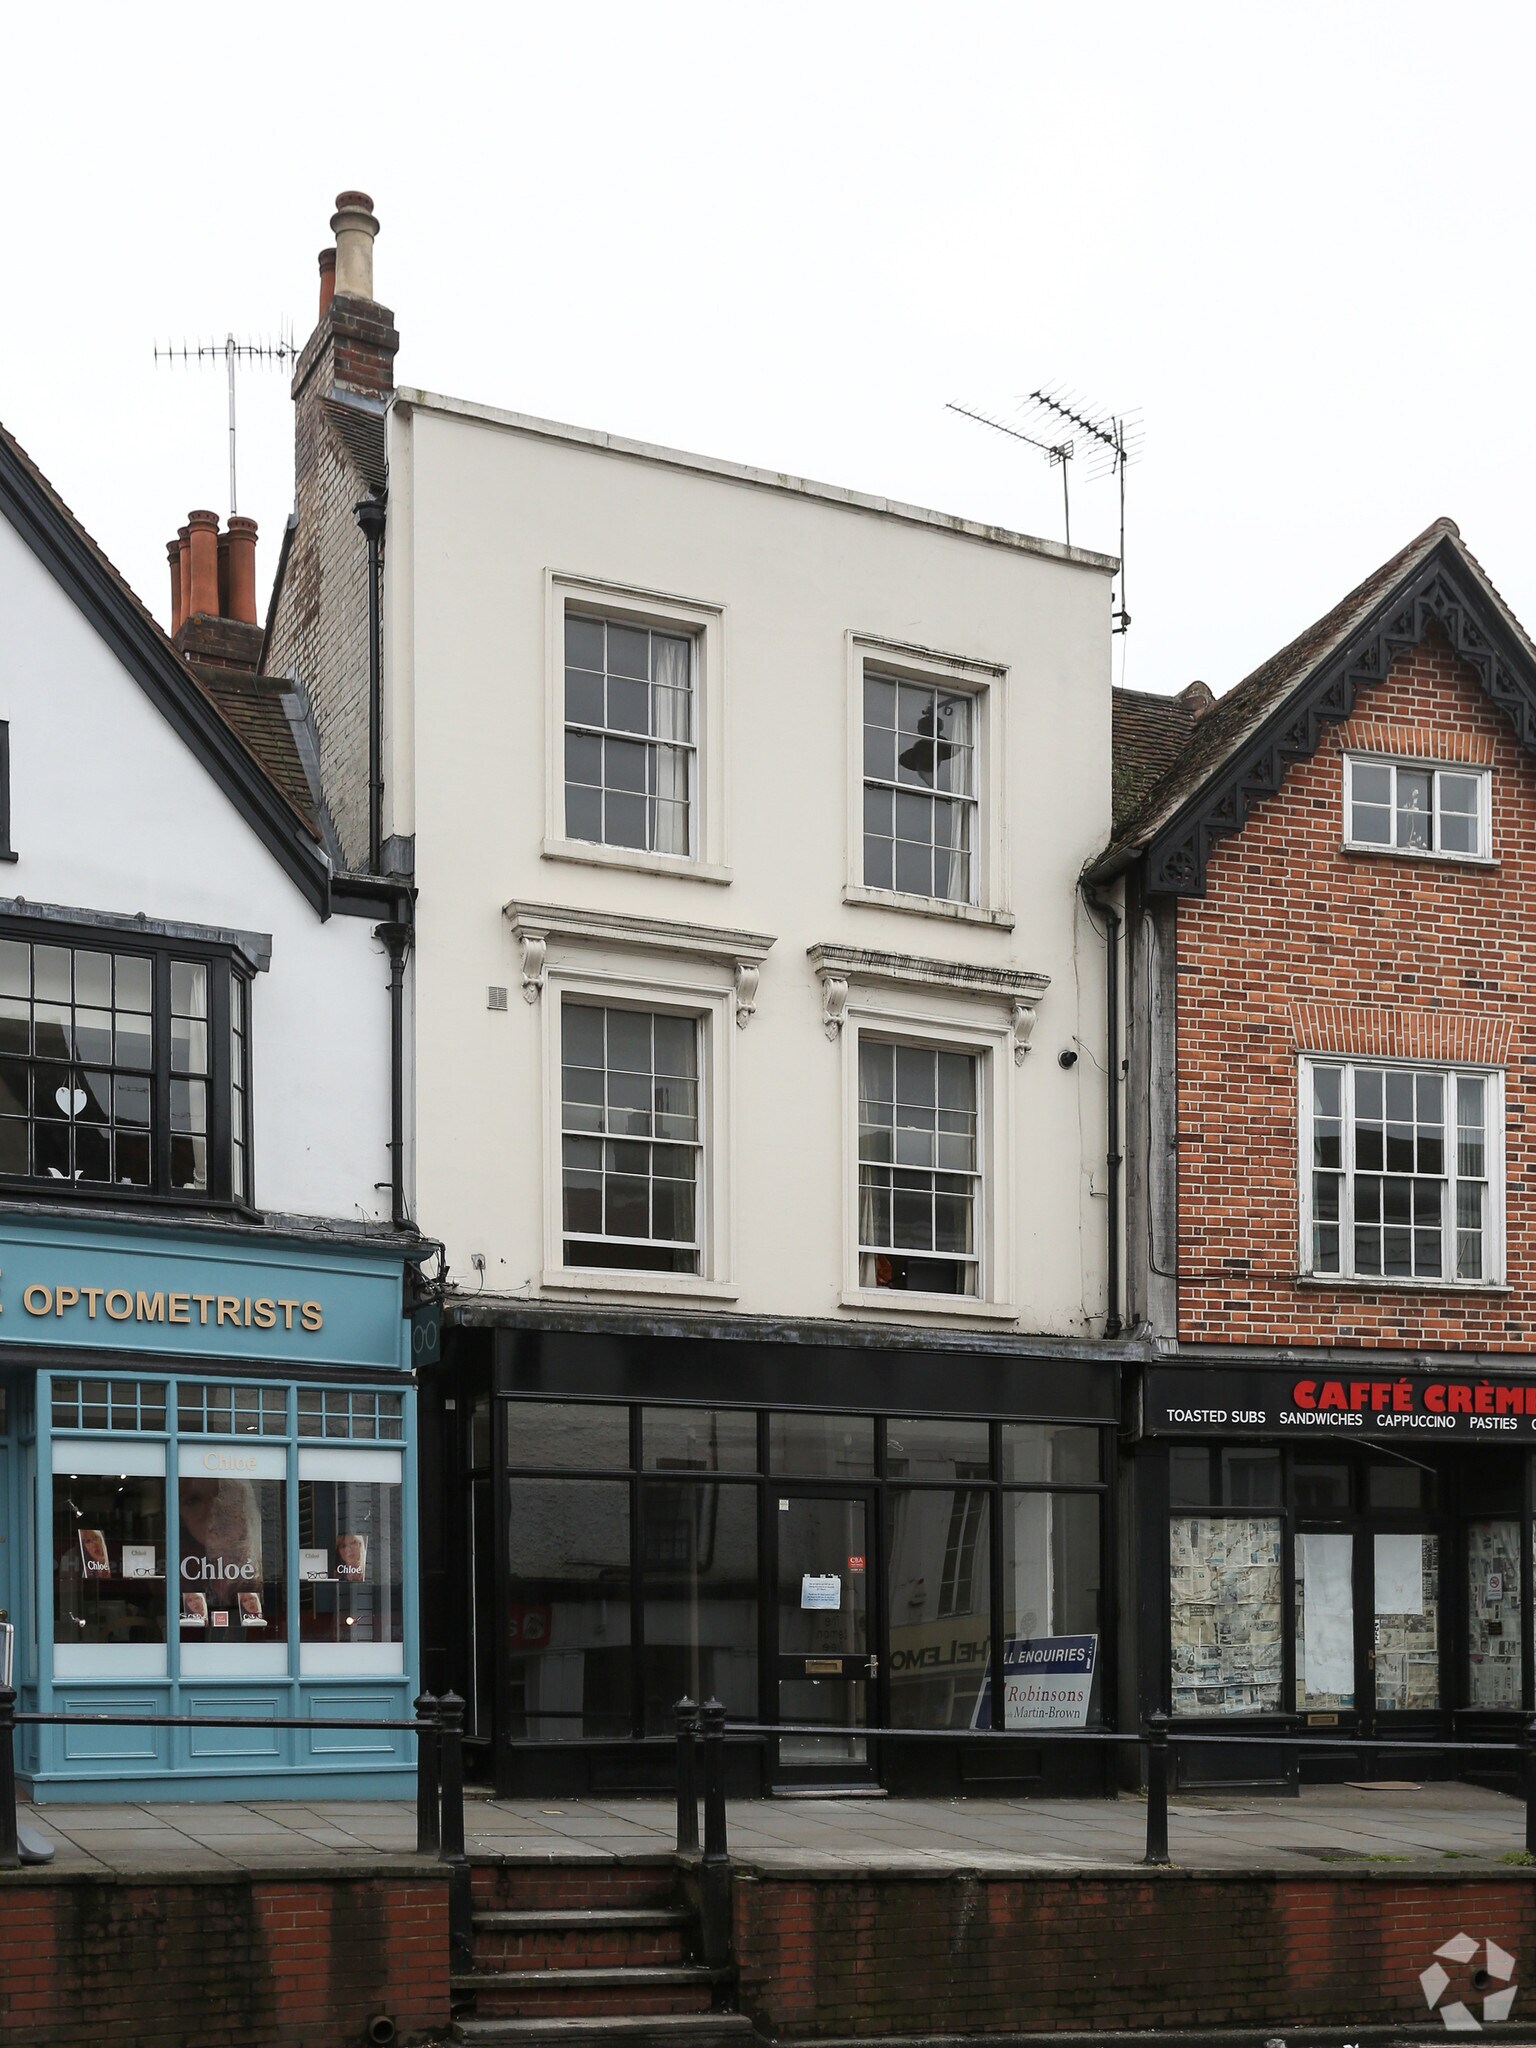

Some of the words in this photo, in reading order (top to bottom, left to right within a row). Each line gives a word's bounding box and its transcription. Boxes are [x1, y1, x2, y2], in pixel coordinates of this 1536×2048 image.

[23, 1283, 323, 1332] OPTOMETRISTS
[1293, 1378, 1414, 1413] CAFFÉ
[1167, 1409, 1228, 1423] TOASTED
[1231, 1411, 1266, 1424] SUBS
[1279, 1412, 1363, 1426] SANDWICHES
[1376, 1414, 1456, 1429] CAPPUCCINO
[1469, 1417, 1518, 1430] PASTIES
[180, 1556, 255, 1580] Chloé
[1003, 1652, 1015, 1664] LL
[1018, 1648, 1085, 1663] ENQUIRIES
[1008, 1685, 1084, 1702] Robinsons
[1014, 1706, 1080, 1718] Martin-Brown
